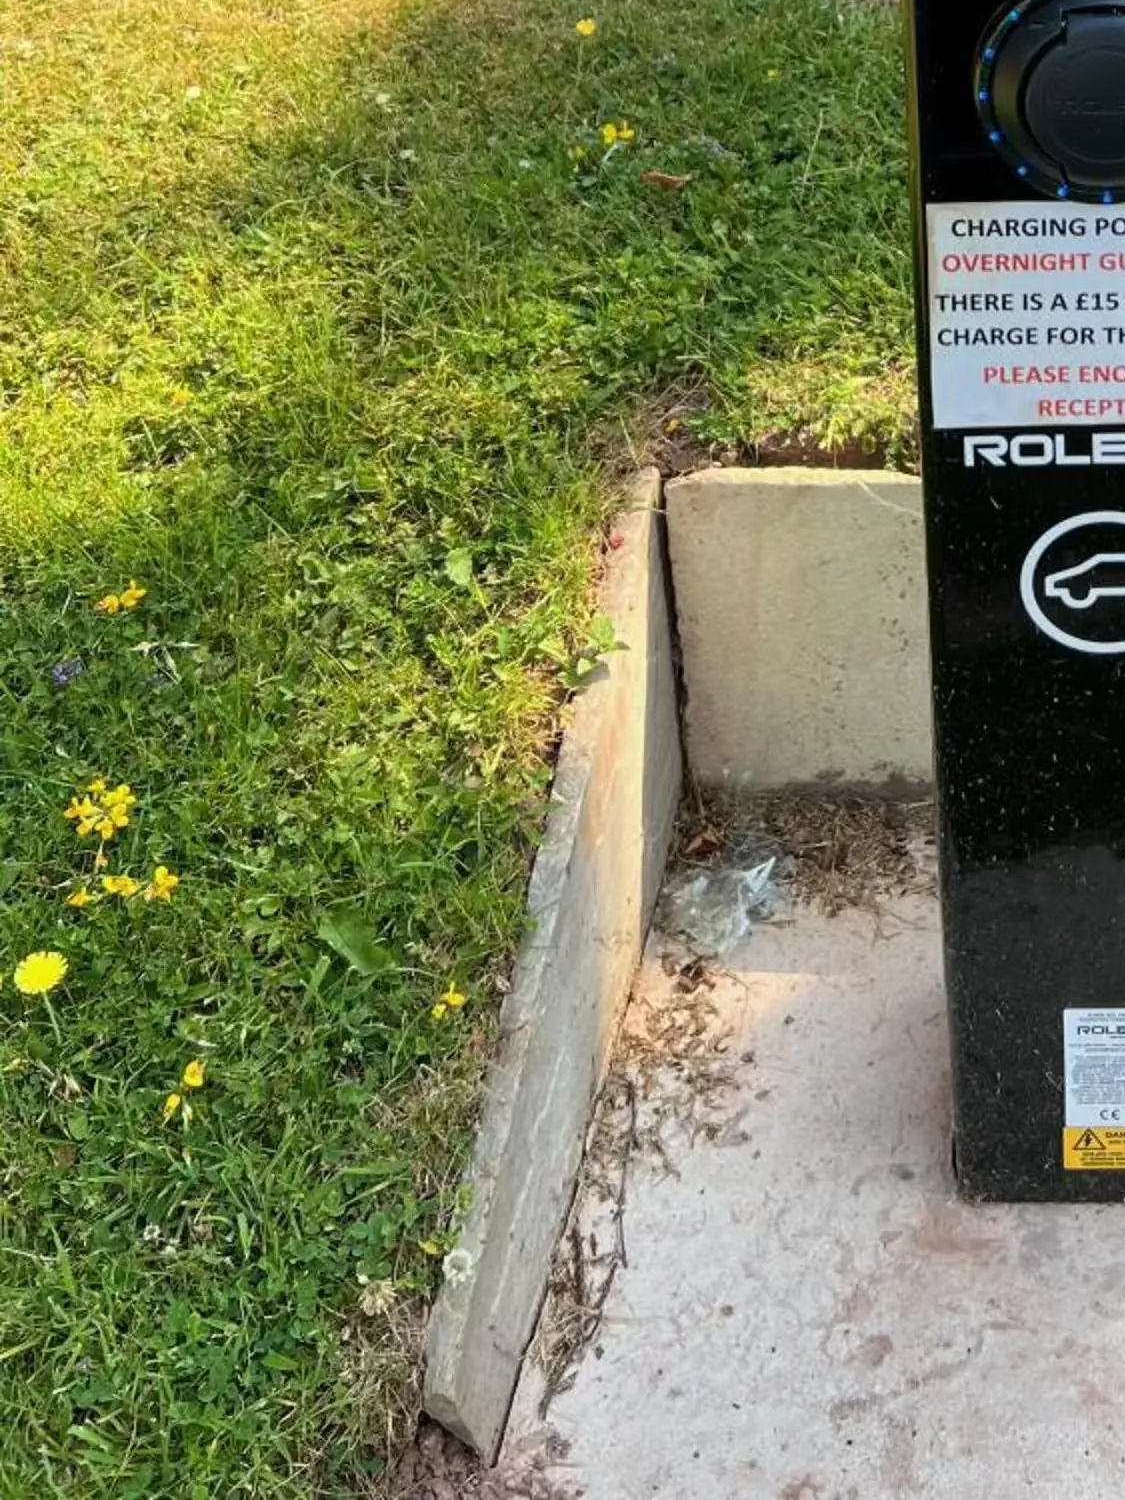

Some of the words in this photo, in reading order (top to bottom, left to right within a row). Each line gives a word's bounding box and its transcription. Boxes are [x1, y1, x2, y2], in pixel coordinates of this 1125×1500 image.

[951, 217, 1087, 237] CHARGING
[942, 253, 1091, 273] OVERNIGHT
[935, 293, 1014, 312] THERE
[1022, 293, 1043, 311] IS
[1050, 293, 1068, 311] A
[1075, 292, 1119, 311] £15
[937, 327, 1038, 347] CHARGE
[1047, 327, 1095, 345] FOR
[984, 365, 1070, 384] PLEASE
